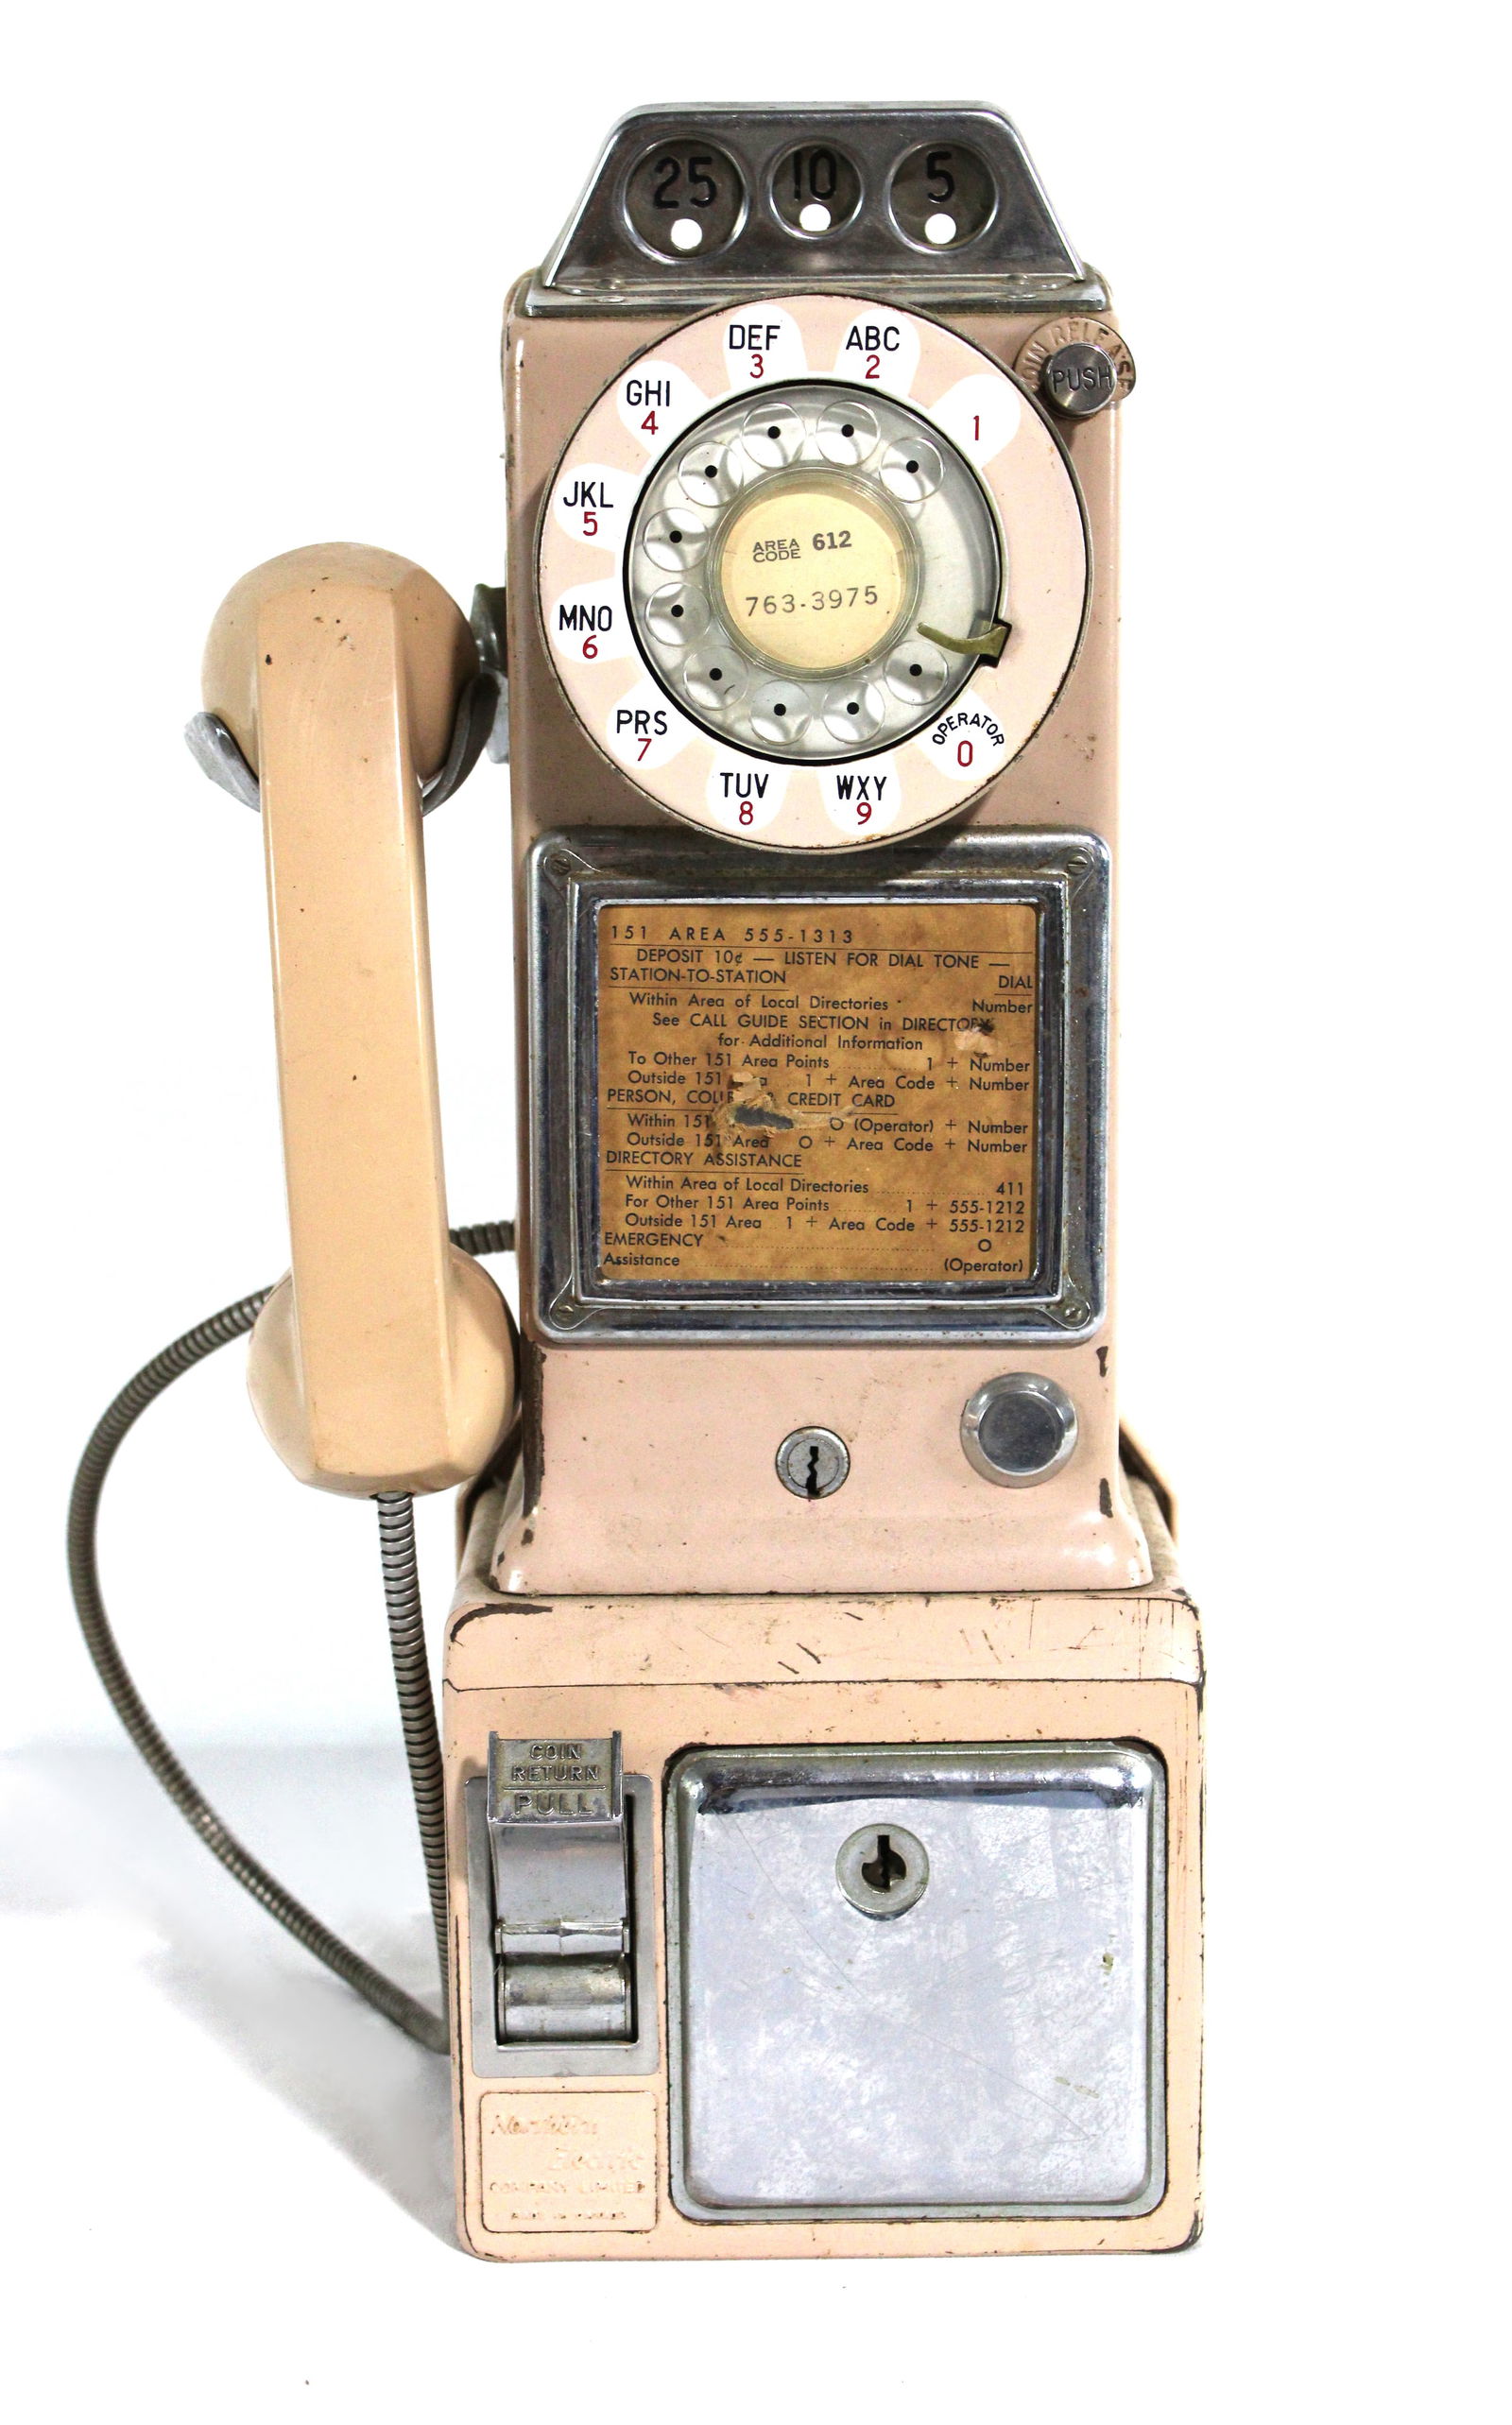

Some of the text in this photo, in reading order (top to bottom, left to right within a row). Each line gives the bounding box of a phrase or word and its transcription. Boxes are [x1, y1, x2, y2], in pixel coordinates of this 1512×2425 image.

[652, 148, 955, 210] 25 10 5
[729, 324, 782, 351] DEF
[845, 326, 901, 352] ABC
[749, 354, 764, 379] 3
[865, 354, 881, 380] 2
[1052, 365, 1113, 393] PUSH
[626, 380, 671, 406] GHI
[641, 411, 659, 435] 4
[972, 415, 980, 440] 1
[562, 481, 614, 508] JKL
[582, 511, 598, 537] 5
[752, 538, 799, 552] AREA
[813, 530, 852, 550] 612
[752, 549, 801, 562] CODE
[746, 585, 878, 617] 763-3975
[558, 605, 612, 633] MNO
[582, 634, 599, 660] 6
[616, 710, 668, 735] PRS
[932, 713, 1005, 748] OPERATOR
[636, 738, 653, 762] 7
[719, 772, 770, 800] TUV
[835, 775, 887, 801] WXY
[738, 800, 754, 826] 8
[856, 801, 871, 825] 9
[612, 925, 851, 943] 151 AREA 555-1313
[637, 949, 703, 962] DEPOSIT
[785, 952, 835, 965] LISTEN
[847, 953, 878, 966] FOR
[889, 954, 923, 967] DIAL
[934, 955, 979, 969] TONE
[610, 967, 1032, 989] STATION-TO-STATION DIAL
[629, 992, 1032, 1013] Within Area of Local Directories Number
[653, 1012, 679, 1026] See
[690, 1013, 727, 1026] CALL
[738, 1014, 787, 1028] GUIDE
[799, 1016, 868, 1029] SECTION
[880, 1017, 891, 1030] in
[717, 1033, 922, 1050] for Additional Information
[628, 1051, 645, 1064] To
[654, 1052, 696, 1065] Other
[706, 1052, 730, 1066] 151
[742, 1055, 778, 1067] Area
[786, 1054, 829, 1068] Points
[927, 1058, 932, 1071] 1
[971, 1056, 1030, 1072] Number
[627, 1070, 685, 1084] Outside
[696, 1072, 720, 1085] 151
[806, 1074, 811, 1087] 1
[849, 1075, 885, 1089] Area
[896, 1075, 935, 1090] Code
[970, 1077, 1028, 1091] Number
[608, 1089, 675, 1105] PERSON,
[788, 1092, 841, 1106] CREDIT
[851, 1093, 895, 1108] CARD
[627, 1113, 675, 1127] Within
[685, 1114, 712, 1128] 151
[854, 1118, 933, 1135] (Operator)
[969, 1120, 1028, 1134] Number
[627, 1132, 684, 1146] Outside
[696, 1131, 720, 1149] 151
[733, 1135, 771, 1148] Area
[847, 1138, 883, 1150] Area
[894, 1138, 933, 1151] Code
[968, 1139, 1027, 1153] Number
[607, 1151, 801, 1167] DIRECTORY ASSISTANCE
[627, 1176, 1022, 1195] Within Area of Local Directories 411
[627, 1195, 648, 1207] For
[656, 1195, 698, 1208] Other
[708, 1195, 732, 1209] 151
[743, 1196, 779, 1210] Area
[787, 1197, 829, 1211] Points
[907, 1199, 912, 1212] 1
[950, 1200, 1024, 1214] 555-1212
[626, 1212, 682, 1227] Outside
[692, 1214, 715, 1228] 151
[726, 1215, 761, 1229] Area
[787, 1216, 792, 1230] 1
[829, 1217, 865, 1230] Area
[876, 1217, 915, 1231] Code
[950, 1219, 1023, 1232] 555-1212
[605, 1232, 703, 1247] EMERGENCY
[604, 1252, 1022, 1275] Assistance (Operator)
[530, 1744, 582, 1761] COIN
[511, 1764, 601, 1782] RETURN
[514, 1793, 594, 1815] PULL
